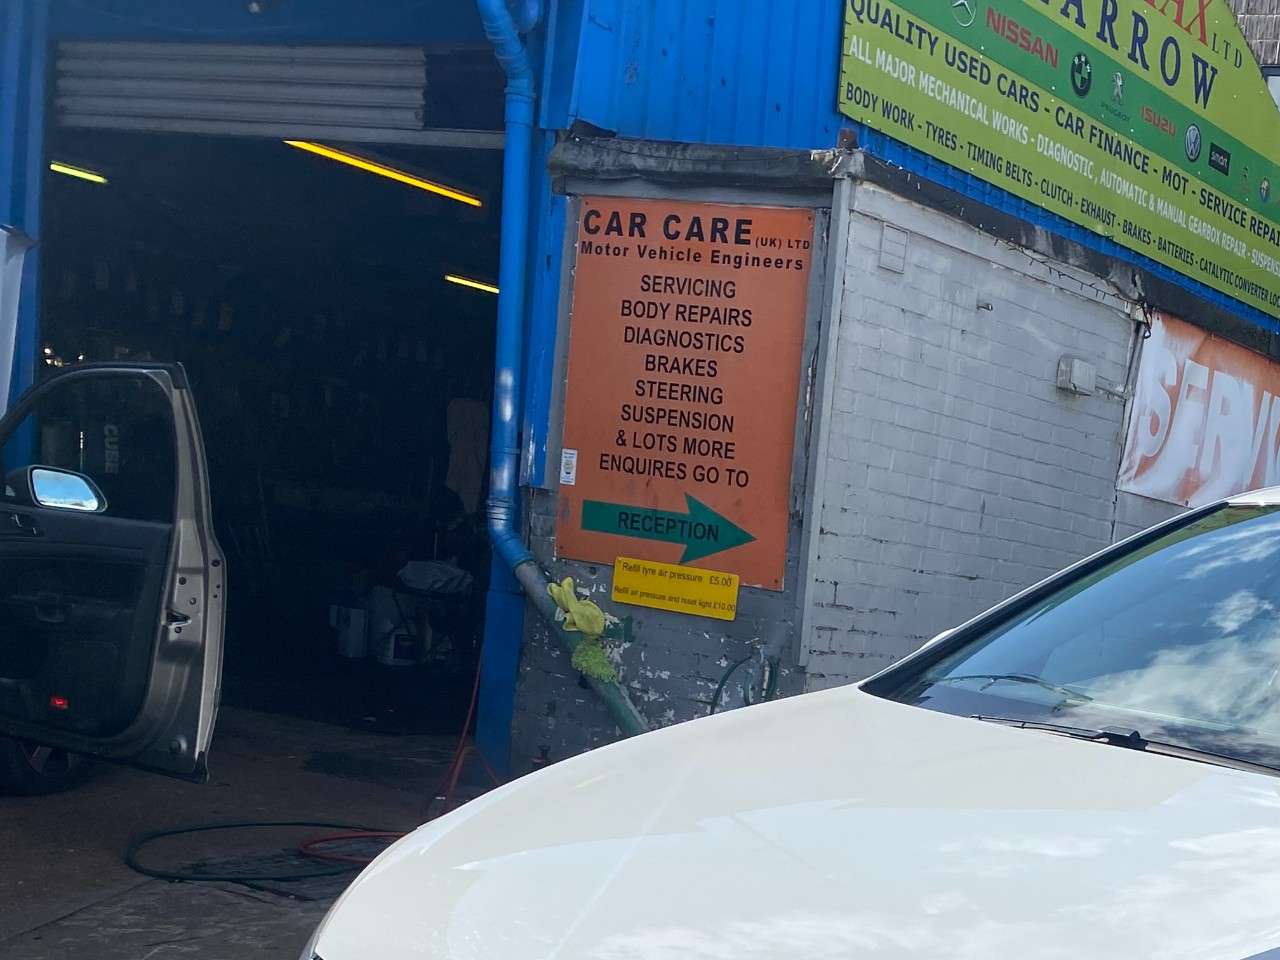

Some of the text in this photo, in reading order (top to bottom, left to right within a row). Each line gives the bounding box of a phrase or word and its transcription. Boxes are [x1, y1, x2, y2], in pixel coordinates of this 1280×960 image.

[986, 6, 1060, 68] NISSAN
[1212, 32, 1242, 68] LTD
[1042, 0, 1218, 110] RROW
[851, 0, 939, 56] QUALITY
[944, 41, 991, 85] USED
[997, 72, 1039, 113] CARS
[1055, 106, 1084, 138] CAR
[1089, 130, 1149, 174] FINANCE
[1162, 166, 1189, 196] MOT
[1200, 188, 1247, 228] SERVICE
[850, 35, 872, 65] ALL
[875, 47, 916, 86] MAJOR
[919, 70, 989, 125] MECHANICAL
[992, 108, 1028, 145] WORKS
[1100, 168, 1148, 208] AUTOMATIC
[1149, 197, 1155, 211] &
[1156, 203, 1187, 228] MANUAL
[1188, 216, 1221, 247] GEARBOX
[1221, 234, 1247, 258] REPAIR
[846, 82, 879, 112] BODY
[881, 98, 914, 131] WORK
[925, 120, 957, 151] TYRES
[967, 141, 1003, 173] TIMING
[1005, 158, 1033, 188] BELTS
[1040, 177, 1073, 207] CLUTCH
[1080, 197, 1117, 229] EXHAUST
[1122, 218, 1152, 246] BRAKES
[1157, 236, 1195, 267] BATTERIES
[1199, 257, 1234, 286] CATALYTIC
[1234, 272, 1269, 303] CONVERTER
[584, 210, 811, 251] CAR CARE (UK) LTD
[581, 241, 804, 271] Motor Vehicle Engineers
[640, 274, 737, 299] SERVICING
[621, 299, 753, 328] BODY REPAIRS
[623, 325, 745, 354] DIAGNOSTICS
[645, 354, 718, 378] BRAKES
[634, 379, 724, 405] STEERING
[620, 404, 734, 433] SUSPENSION
[615, 430, 736, 460] & LOTS MORE
[599, 453, 687, 481] ENQUIRES
[693, 460, 720, 485] GO
[726, 468, 749, 488] TO
[617, 511, 719, 543] RECEPTION
[622, 562, 733, 588] Refill tyre air pressure £5.00
